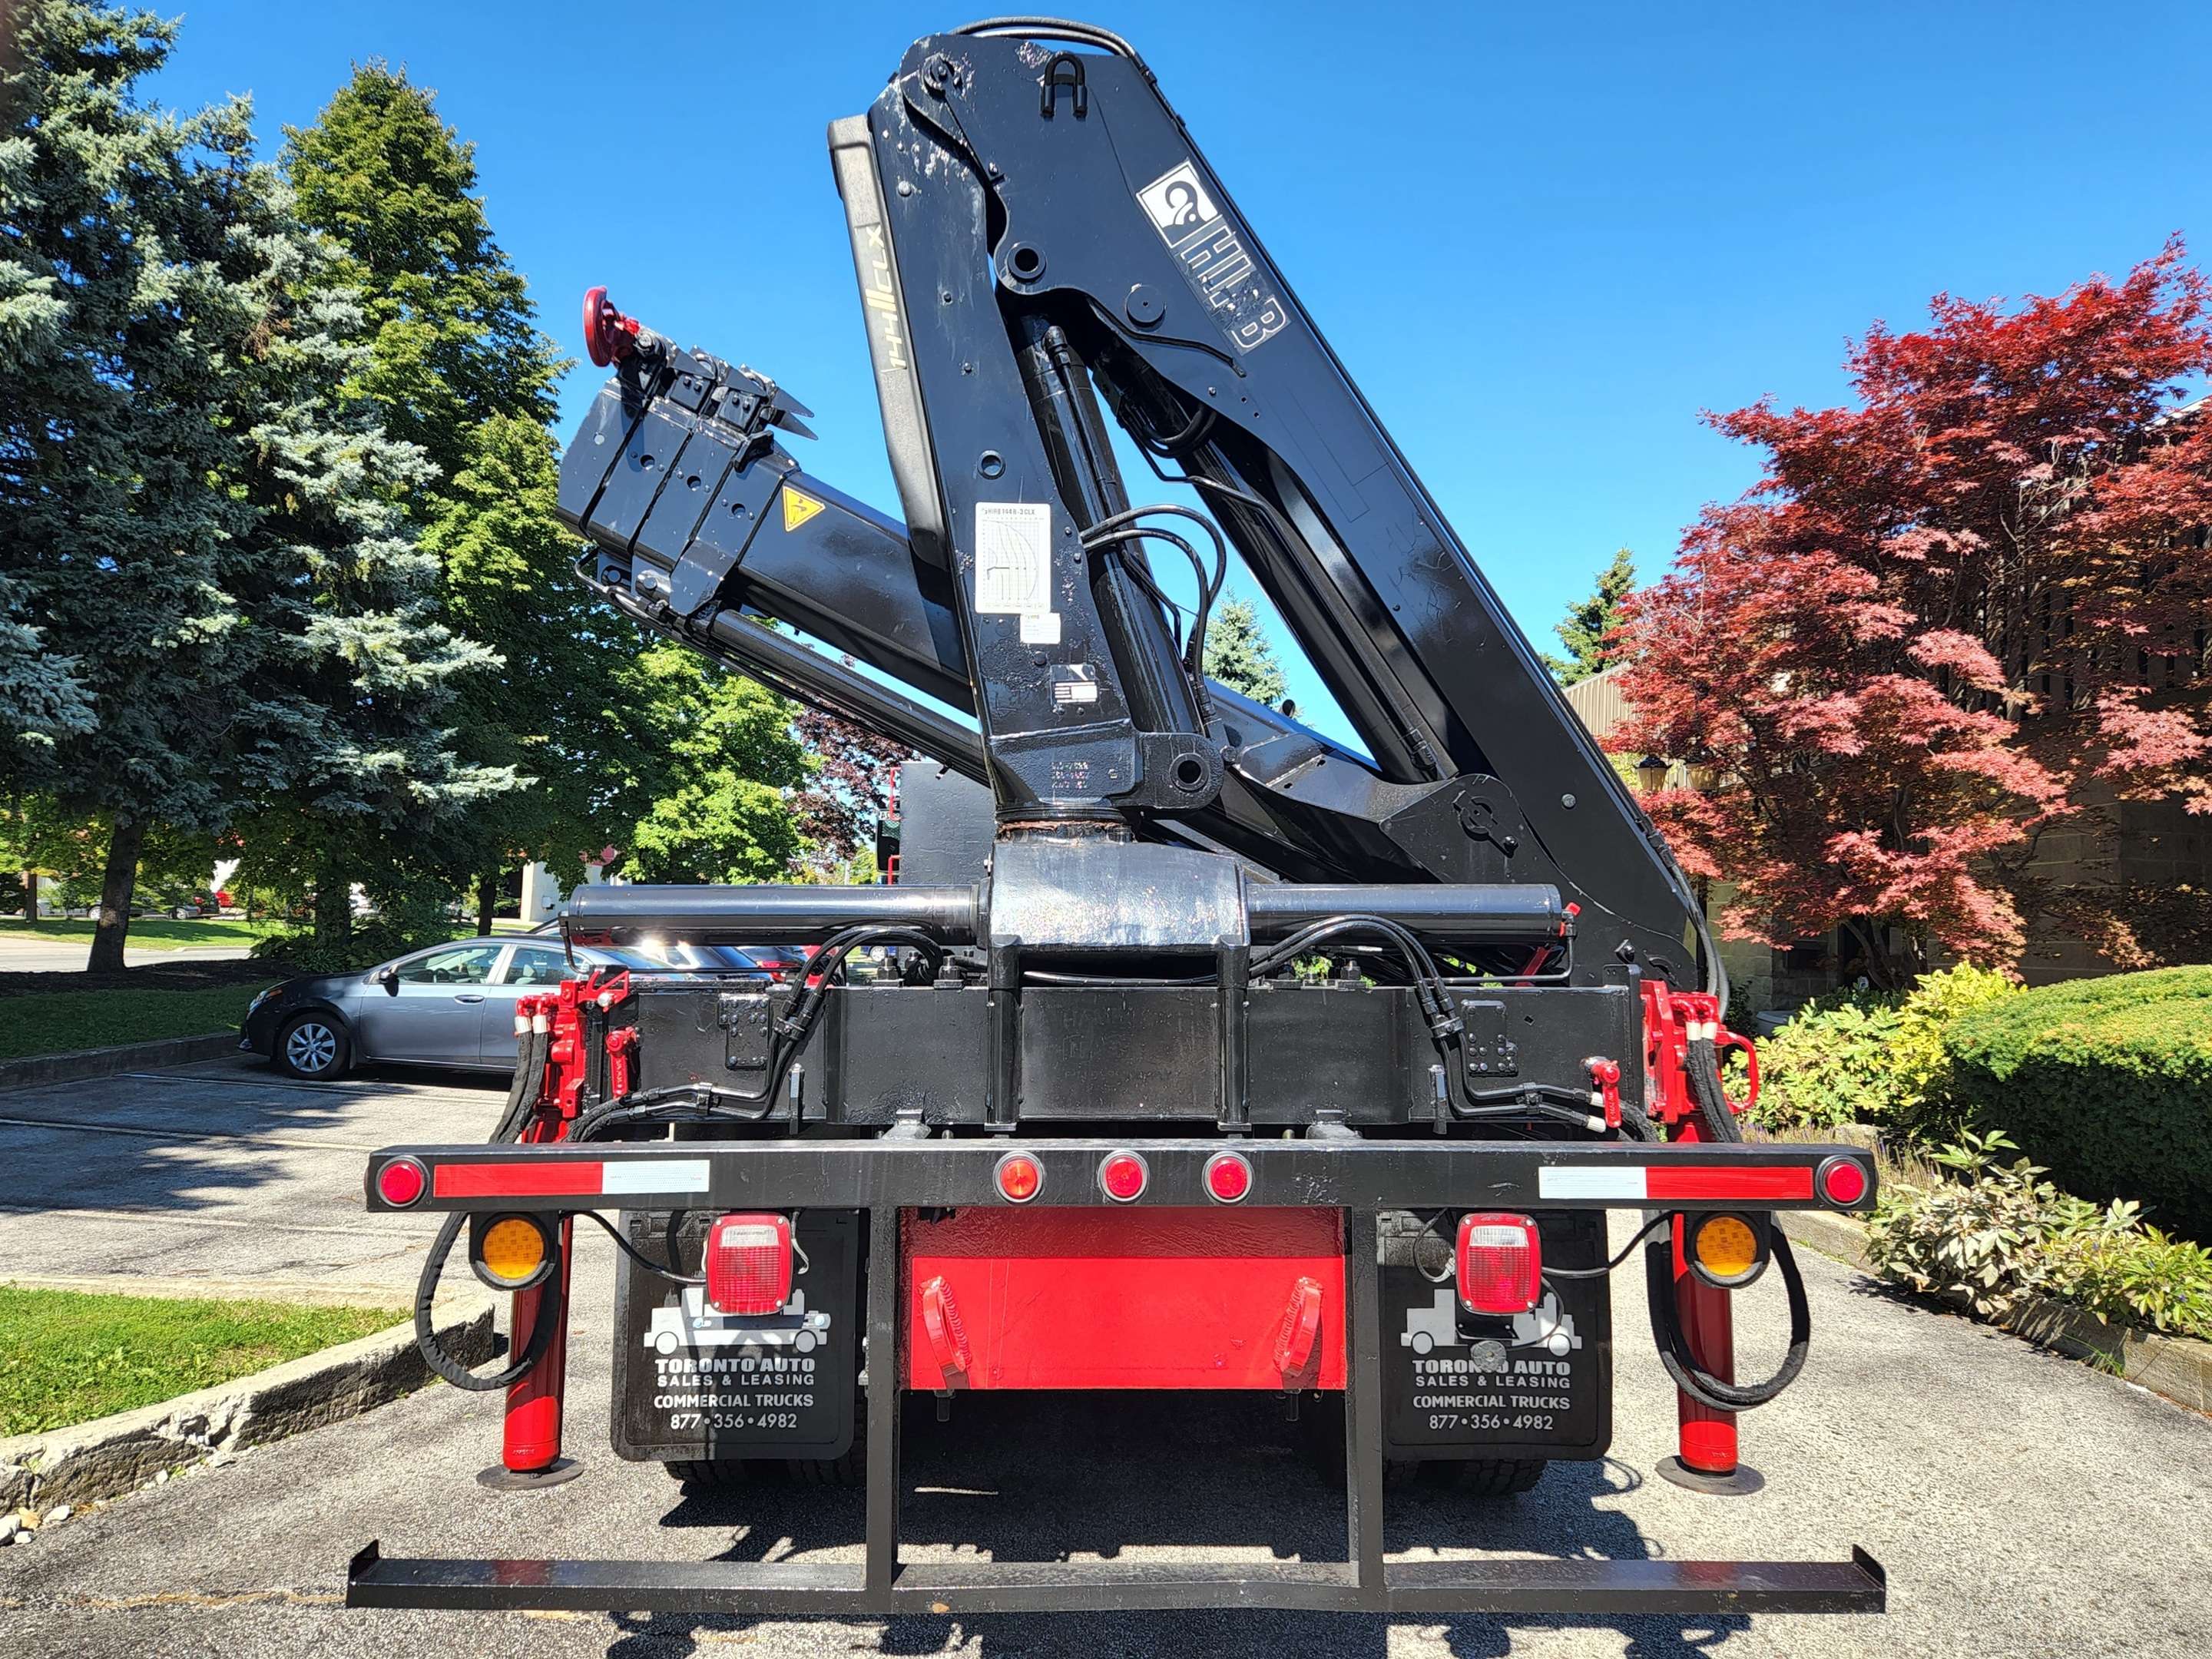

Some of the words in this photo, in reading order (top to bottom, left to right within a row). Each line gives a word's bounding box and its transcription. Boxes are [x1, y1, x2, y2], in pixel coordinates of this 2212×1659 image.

[654, 1358, 755, 1374] TORONTO
[760, 1357, 816, 1373] AUTO
[1412, 1359, 1509, 1374] TORONO
[1514, 1360, 1571, 1376] AUTO
[657, 1374, 714, 1387] SALES
[721, 1374, 732, 1386] &
[741, 1373, 815, 1386] LEASING
[1416, 1375, 1469, 1387] SALES
[1477, 1375, 1488, 1386] &
[1495, 1376, 1571, 1389] LEASING
[654, 1394, 751, 1409] COMMERCIAL
[755, 1393, 814, 1407] TRUCKS
[1412, 1395, 1506, 1409] COMMERCIAL
[1510, 1395, 1571, 1410] TRUCKS
